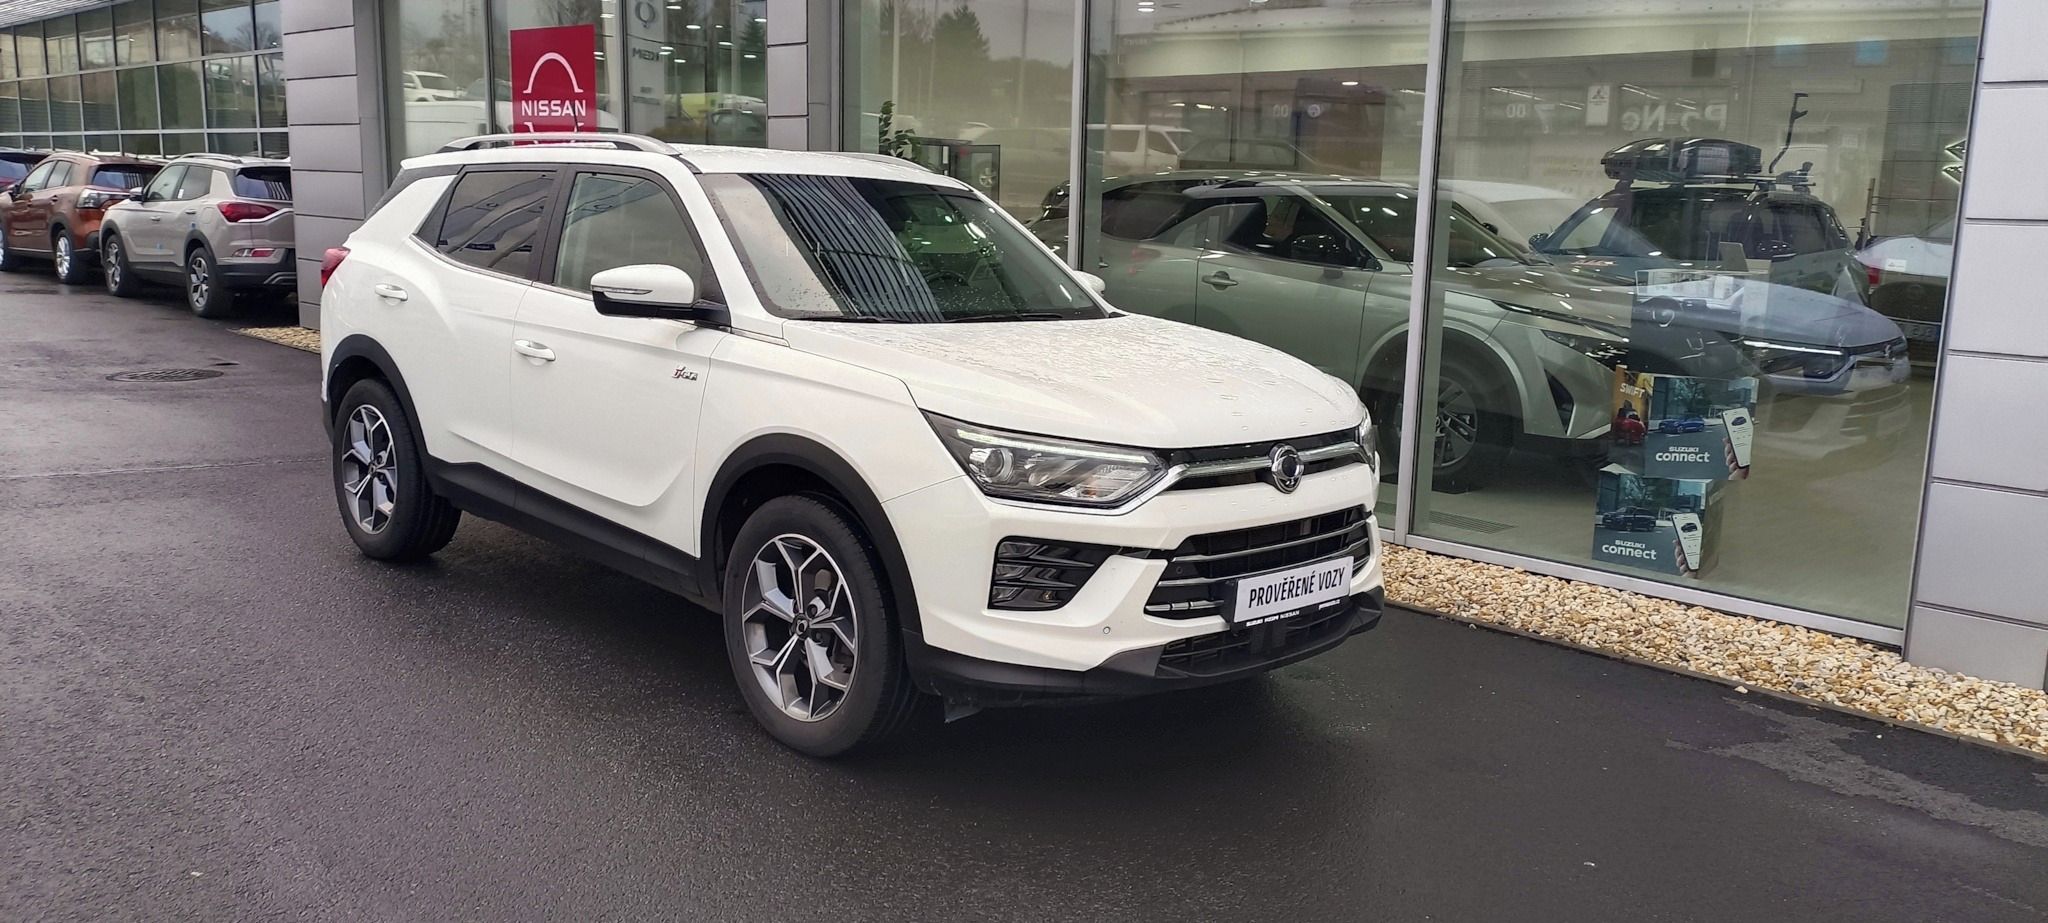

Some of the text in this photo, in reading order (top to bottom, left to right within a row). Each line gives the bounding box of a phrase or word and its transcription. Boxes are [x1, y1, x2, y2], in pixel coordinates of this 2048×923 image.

[521, 99, 586, 117] NISSAN
[1620, 382, 1646, 398] SWIFT
[1655, 451, 1710, 463] connect
[1602, 544, 1657, 560] connect
[1615, 539, 1646, 549] SUZUKI
[1248, 567, 1345, 608] PROVĚŘENÉ VOZY
